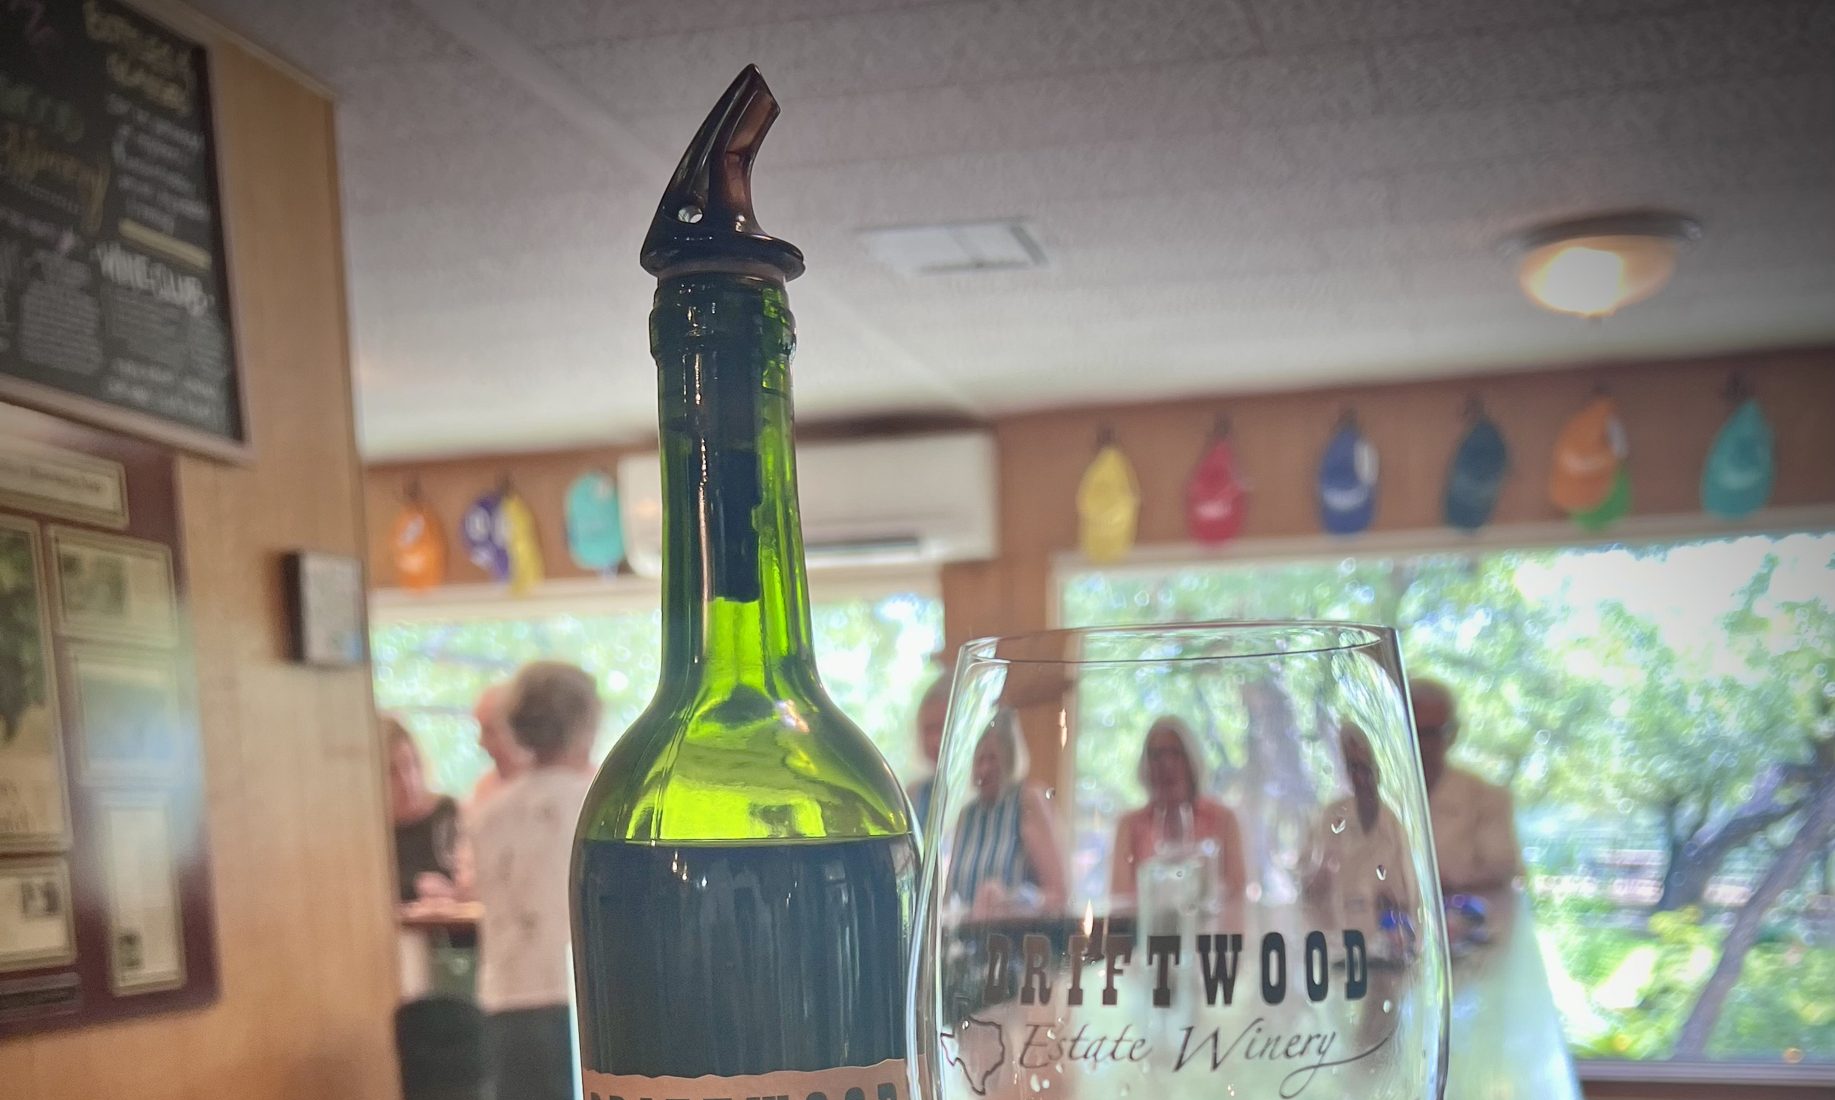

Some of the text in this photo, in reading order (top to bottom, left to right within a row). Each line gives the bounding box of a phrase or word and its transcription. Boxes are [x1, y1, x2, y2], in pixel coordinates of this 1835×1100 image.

[982, 929, 1368, 1008] DRIFTWOOD
[1018, 1017, 1370, 1098] Estate Winery
